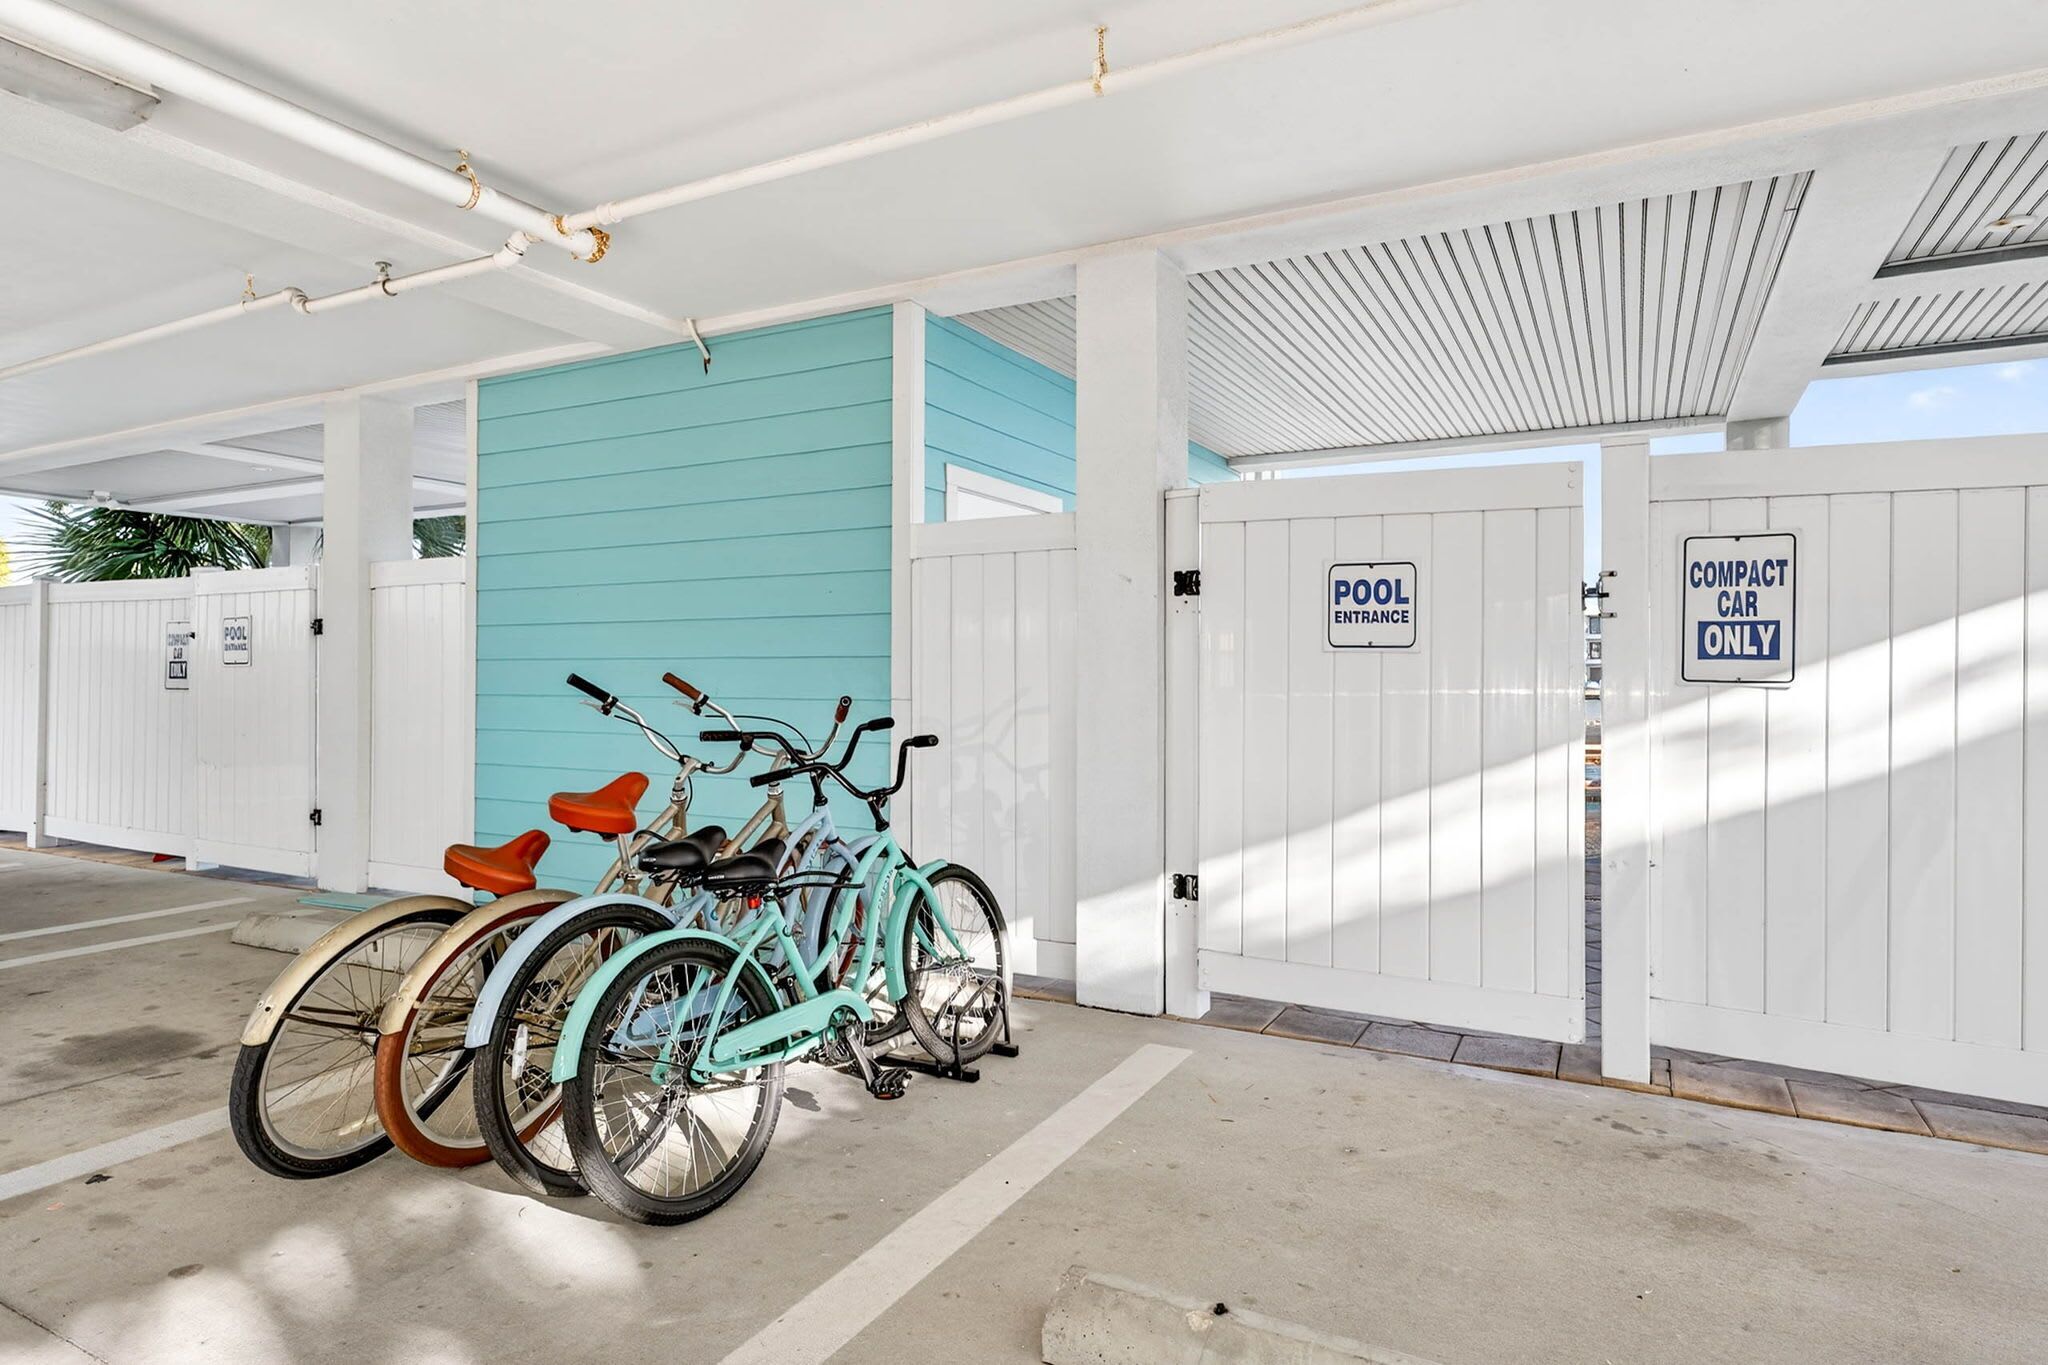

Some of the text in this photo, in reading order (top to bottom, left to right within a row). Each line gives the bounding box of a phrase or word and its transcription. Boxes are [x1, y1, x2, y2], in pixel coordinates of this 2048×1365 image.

[1690, 559, 1788, 588] COMPACT
[1335, 578, 1409, 606] POOL
[1717, 590, 1758, 617] CAR
[1335, 609, 1409, 624] ENTRANCE
[224, 626, 247, 641] POOL
[1704, 623, 1776, 656] ONLY
